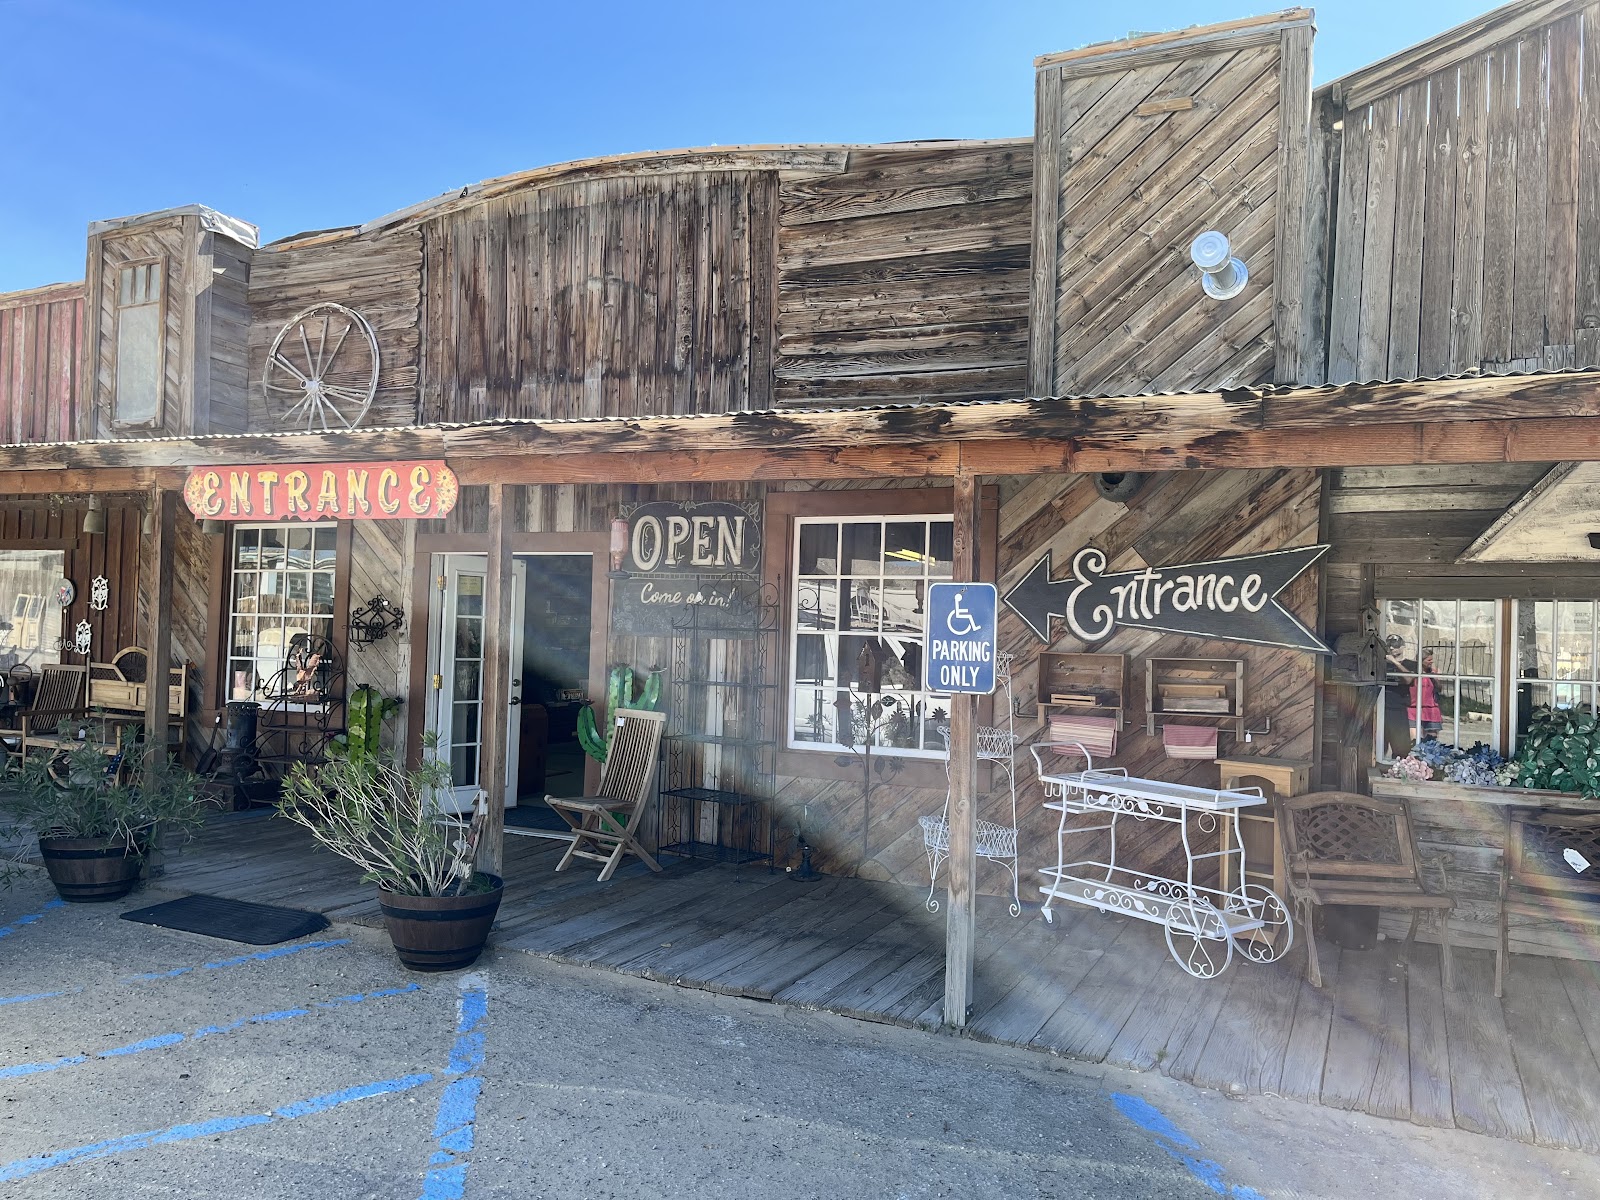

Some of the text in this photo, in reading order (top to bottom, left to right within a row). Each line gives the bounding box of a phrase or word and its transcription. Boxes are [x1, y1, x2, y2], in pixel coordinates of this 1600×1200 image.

[203, 465, 432, 515] ENTRANCE
[631, 515, 746, 571] OPEN
[641, 582, 682, 604] Come
[1066, 548, 1268, 641] Entrance
[932, 639, 991, 662] PARKING
[940, 664, 980, 687] ONLY
